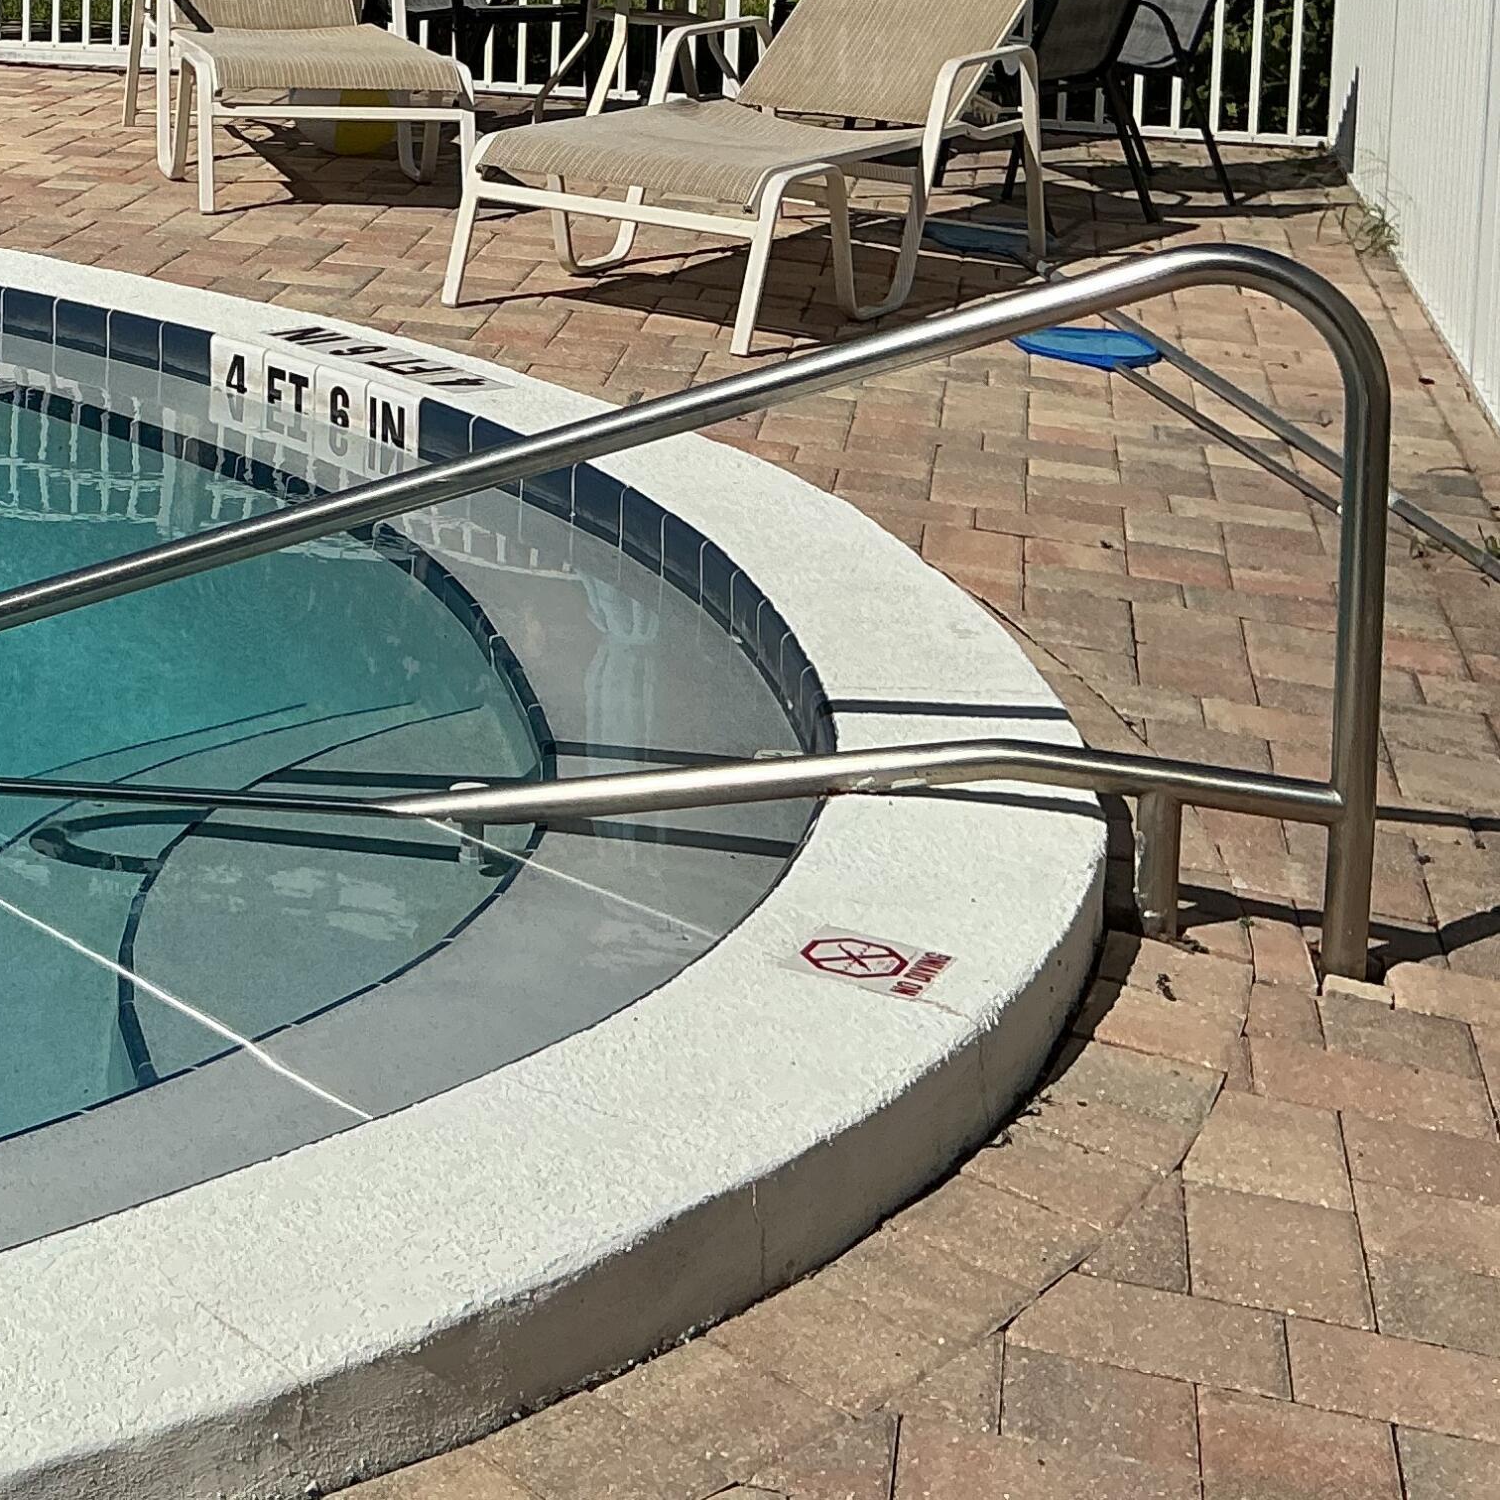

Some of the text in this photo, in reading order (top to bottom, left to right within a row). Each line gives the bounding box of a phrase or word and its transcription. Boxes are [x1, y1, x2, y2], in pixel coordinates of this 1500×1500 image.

[267, 326, 351, 346] IN
[362, 358, 456, 375] FT
[225, 353, 406, 450] 4 FT 6 IN
[903, 952, 953, 983] DIVING
[889, 980, 923, 996] NO
